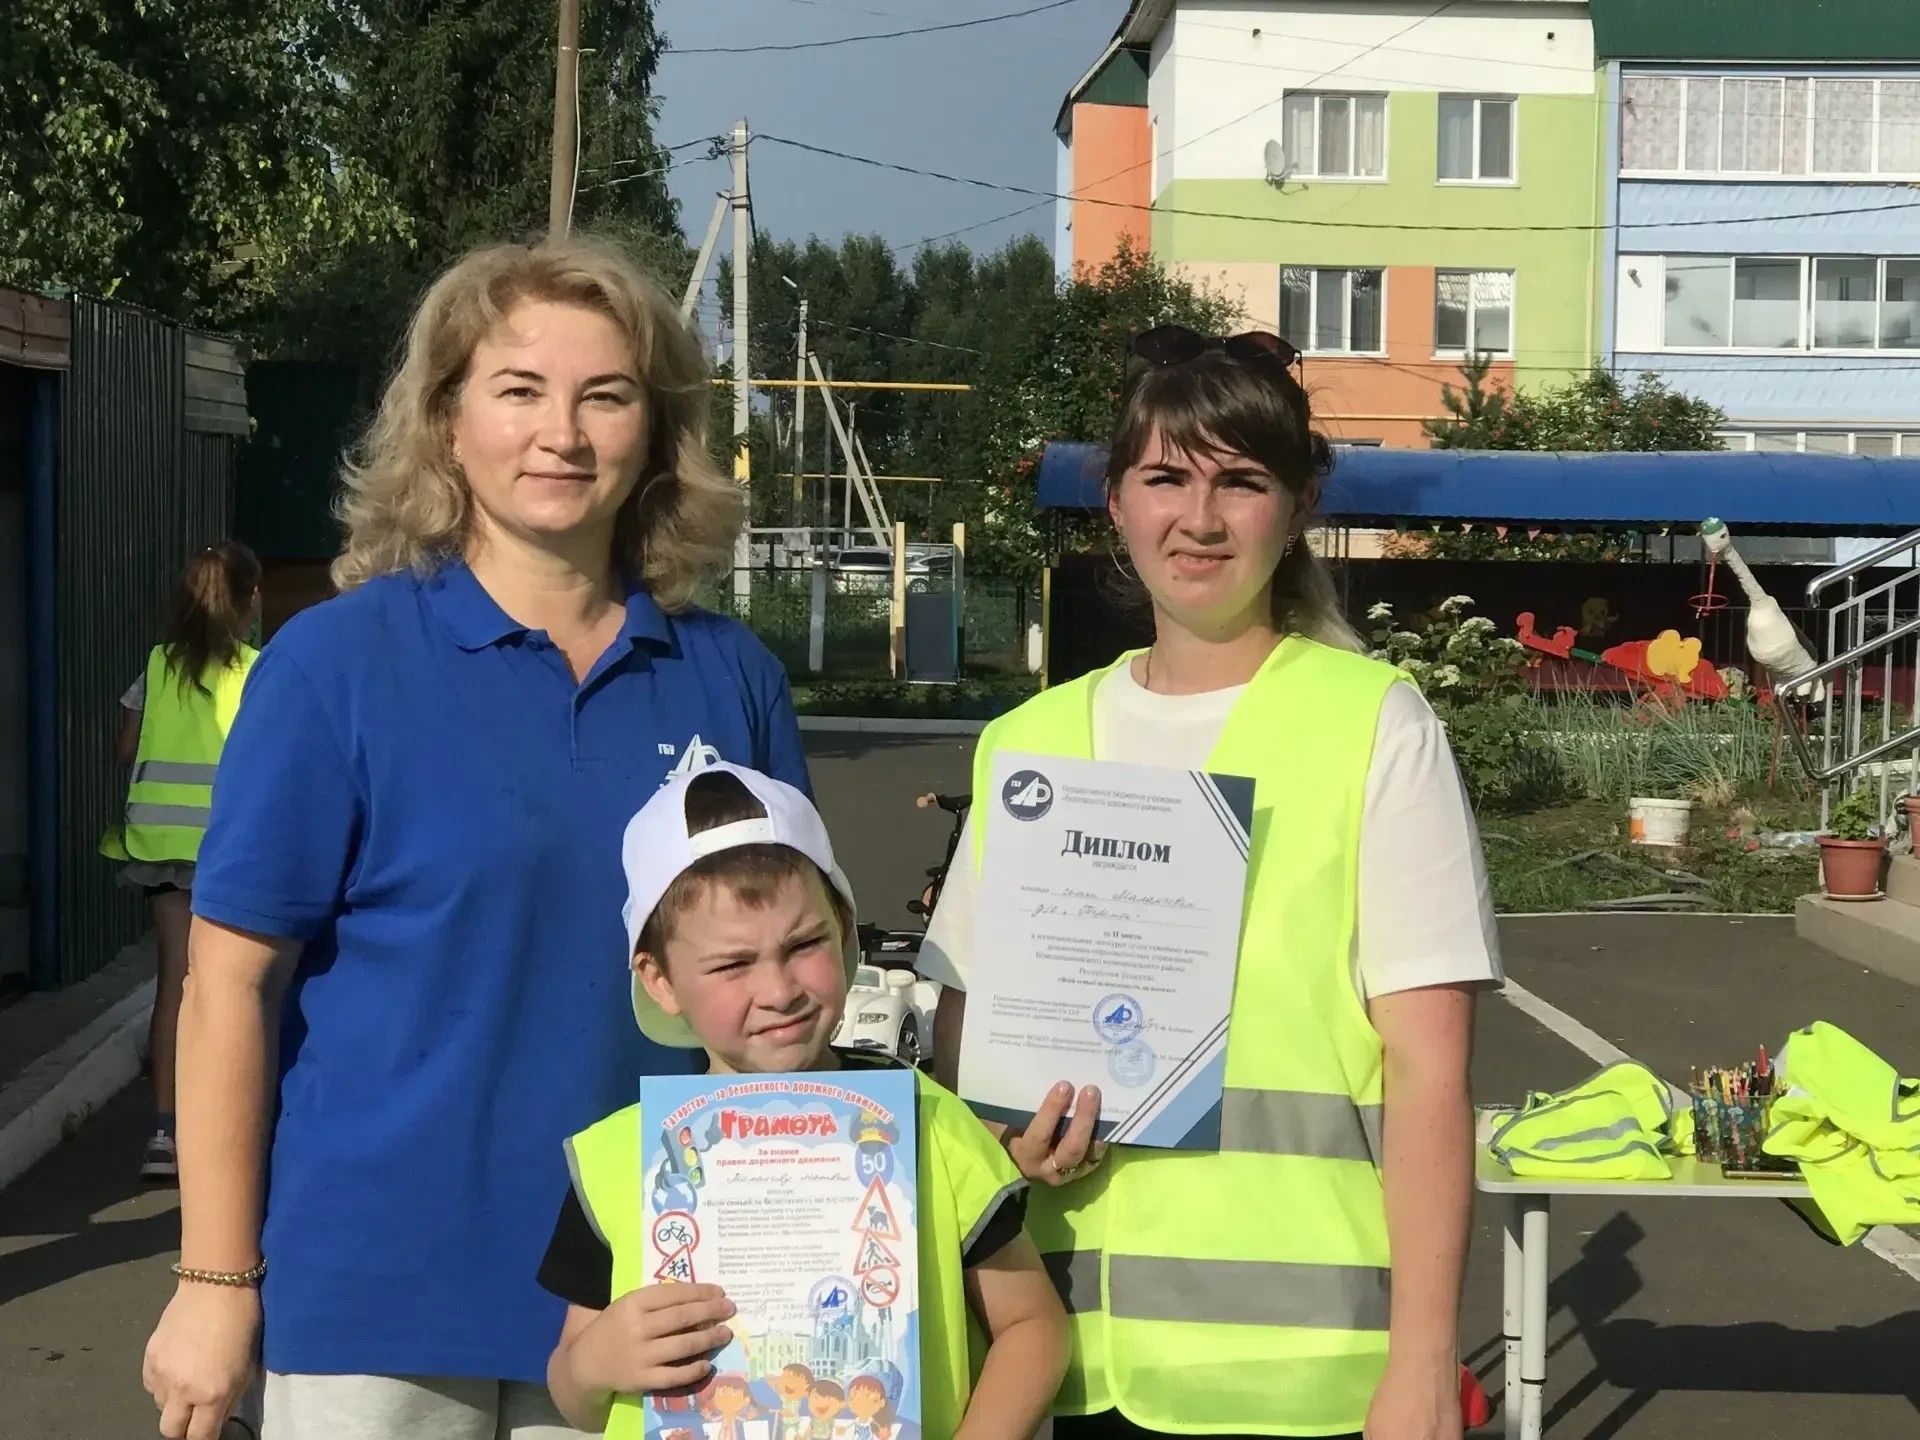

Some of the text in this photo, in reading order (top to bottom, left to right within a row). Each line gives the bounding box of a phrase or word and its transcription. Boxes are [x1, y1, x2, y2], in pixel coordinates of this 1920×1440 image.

[1061, 829, 1172, 864] Диплом
[663, 1096, 708, 1129] Татарстан
[792, 1080, 843, 1098] дорожного
[749, 1157, 796, 1167] дорожного
[797, 1155, 842, 1165] движения
[862, 1153, 887, 1174] 50
